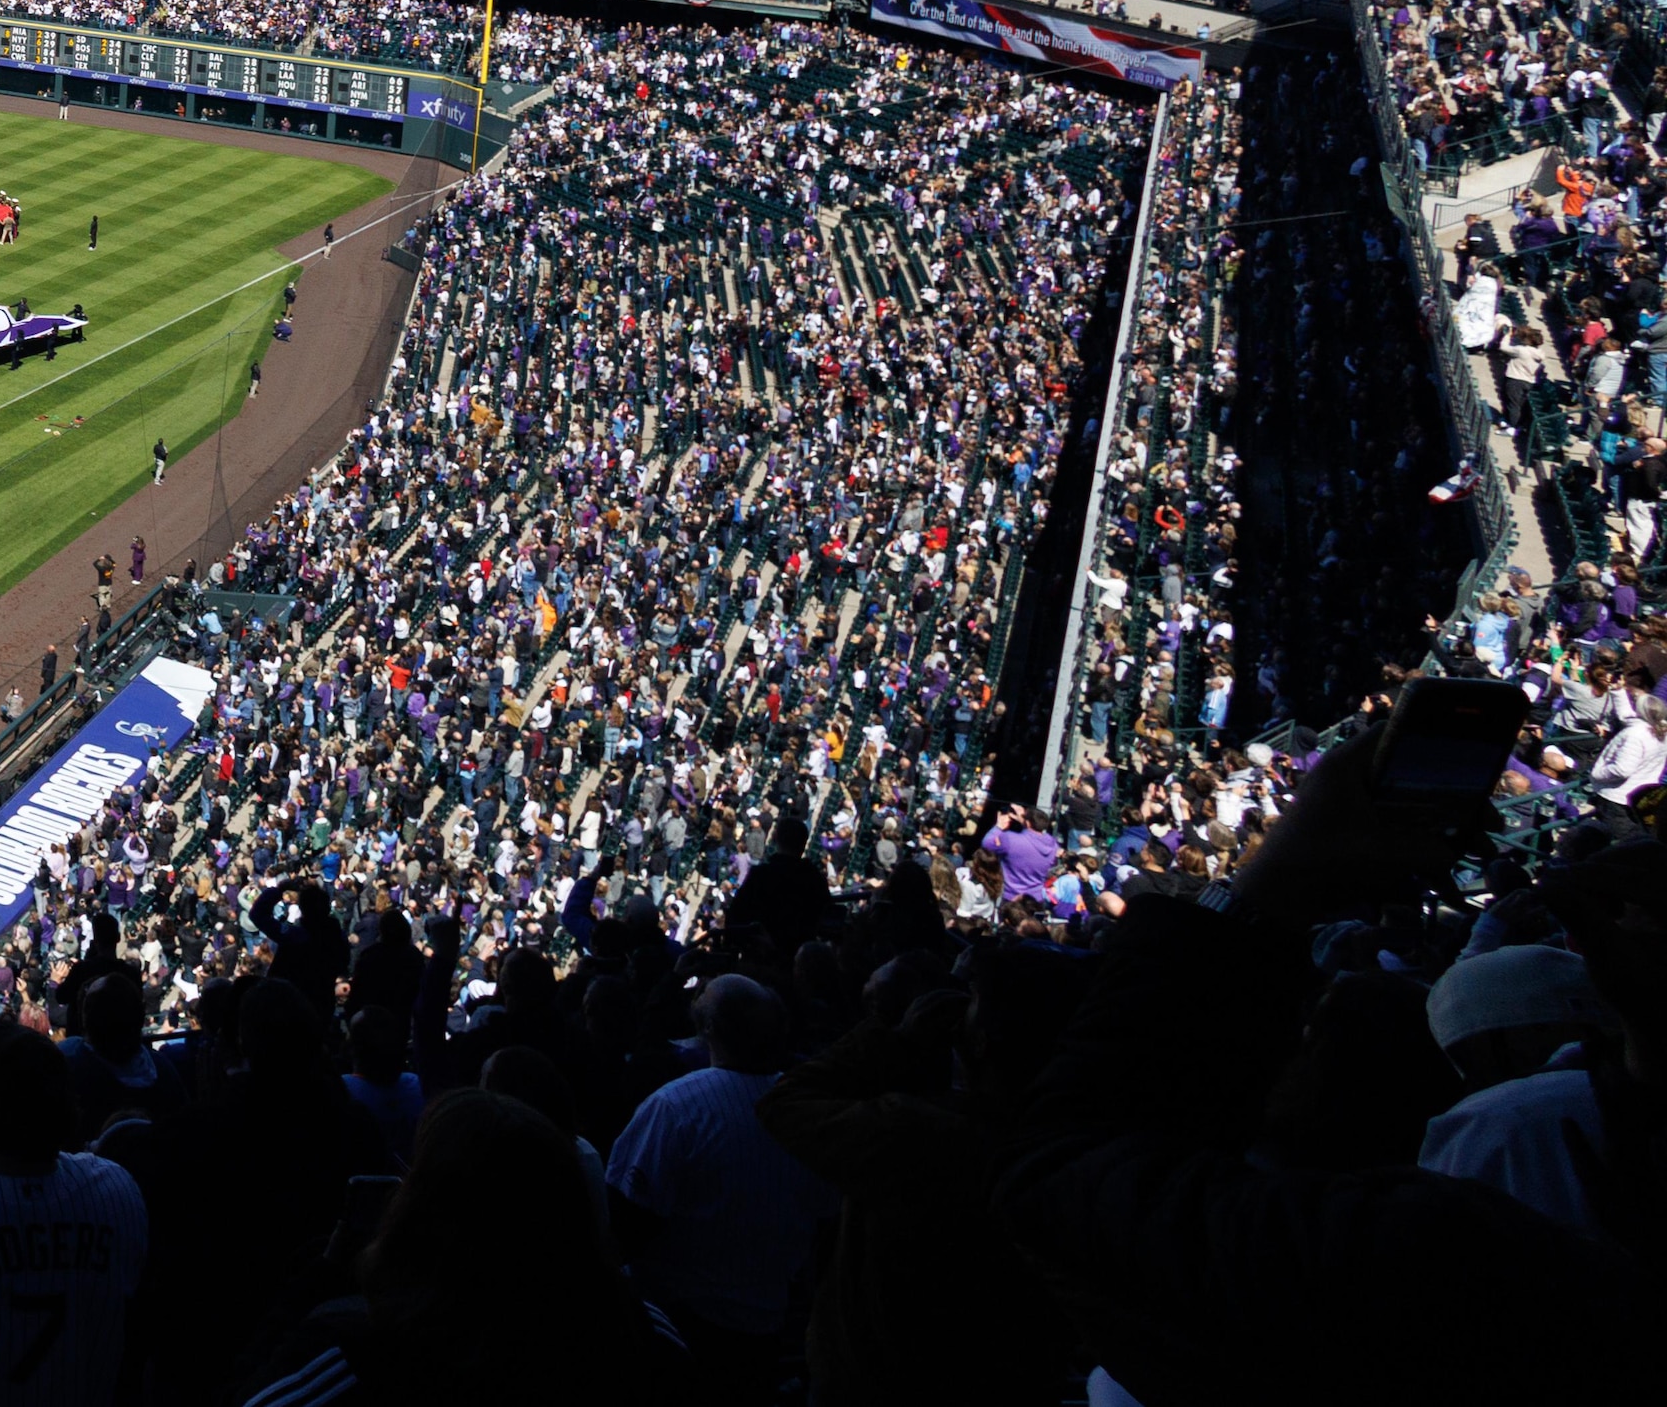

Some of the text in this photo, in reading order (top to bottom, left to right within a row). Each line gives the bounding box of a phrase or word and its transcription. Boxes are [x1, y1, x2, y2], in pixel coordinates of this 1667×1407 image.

[12, 36, 55, 48] NYY 29
[930, 6, 1147, 67] the land of the free and the home of the brave?
[76, 44, 90, 53] BOS
[109, 40, 121, 48] 34
[142, 44, 188, 57] CHC 22
[11, 53, 26, 61] CWS
[12, 45, 55, 57] TOR 84
[75, 54, 119, 66] CIN 51
[75, 62, 87, 70] TEX
[141, 53, 187, 66] CLE 54
[209, 53, 257, 66] BAL 38
[141, 62, 186, 75] TB 36
[209, 62, 257, 75] PIT 23
[280, 62, 329, 76] SEA 22
[140, 71, 186, 83] MIN 17
[208, 71, 256, 84] MIL 39
[279, 72, 327, 84] LAA 48
[352, 72, 402, 85] ATL 66
[1155, 77, 1166, 87] PM
[243, 85, 255, 93] 58
[278, 81, 327, 94] HOU 53
[351, 81, 402, 94] ARI 57
[314, 95, 326, 103] 59
[351, 91, 401, 104] NYM 26
[388, 105, 400, 113] 54
[421, 98, 465, 125] xfinity
[29, 743, 142, 821] ROCKIES
[10, 1296, 67, 1384] 7
